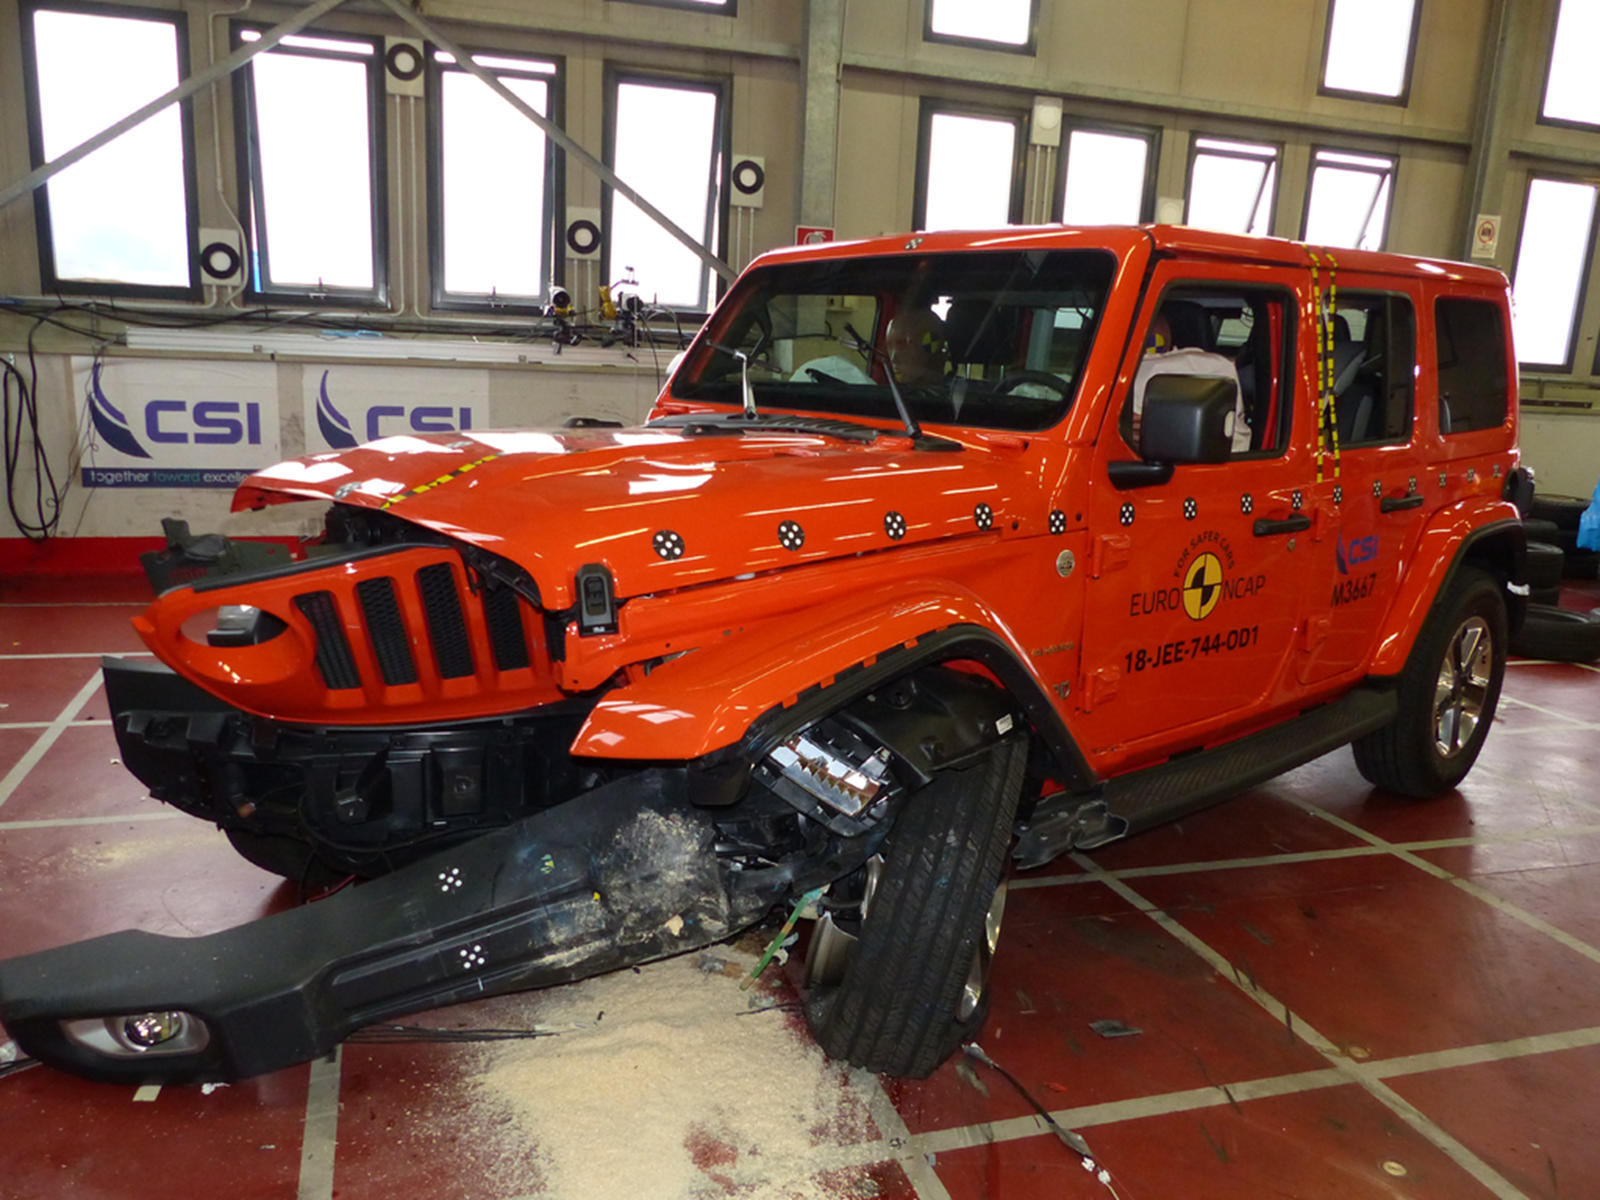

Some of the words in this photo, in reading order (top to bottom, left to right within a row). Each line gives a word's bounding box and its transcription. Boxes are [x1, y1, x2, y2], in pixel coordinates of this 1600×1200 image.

[145, 400, 261, 444] CSI
[366, 406, 472, 439] CSI
[91, 470, 150, 485] together
[153, 471, 200, 482] toward
[1174, 548, 1190, 577] FOR
[1190, 530, 1220, 550] SAFER
[1220, 538, 1235, 570] CARS
[1348, 535, 1378, 566] CSI
[1130, 587, 1180, 616] EURO
[1223, 574, 1266, 600] NCAP
[1329, 572, 1377, 608] M3667
